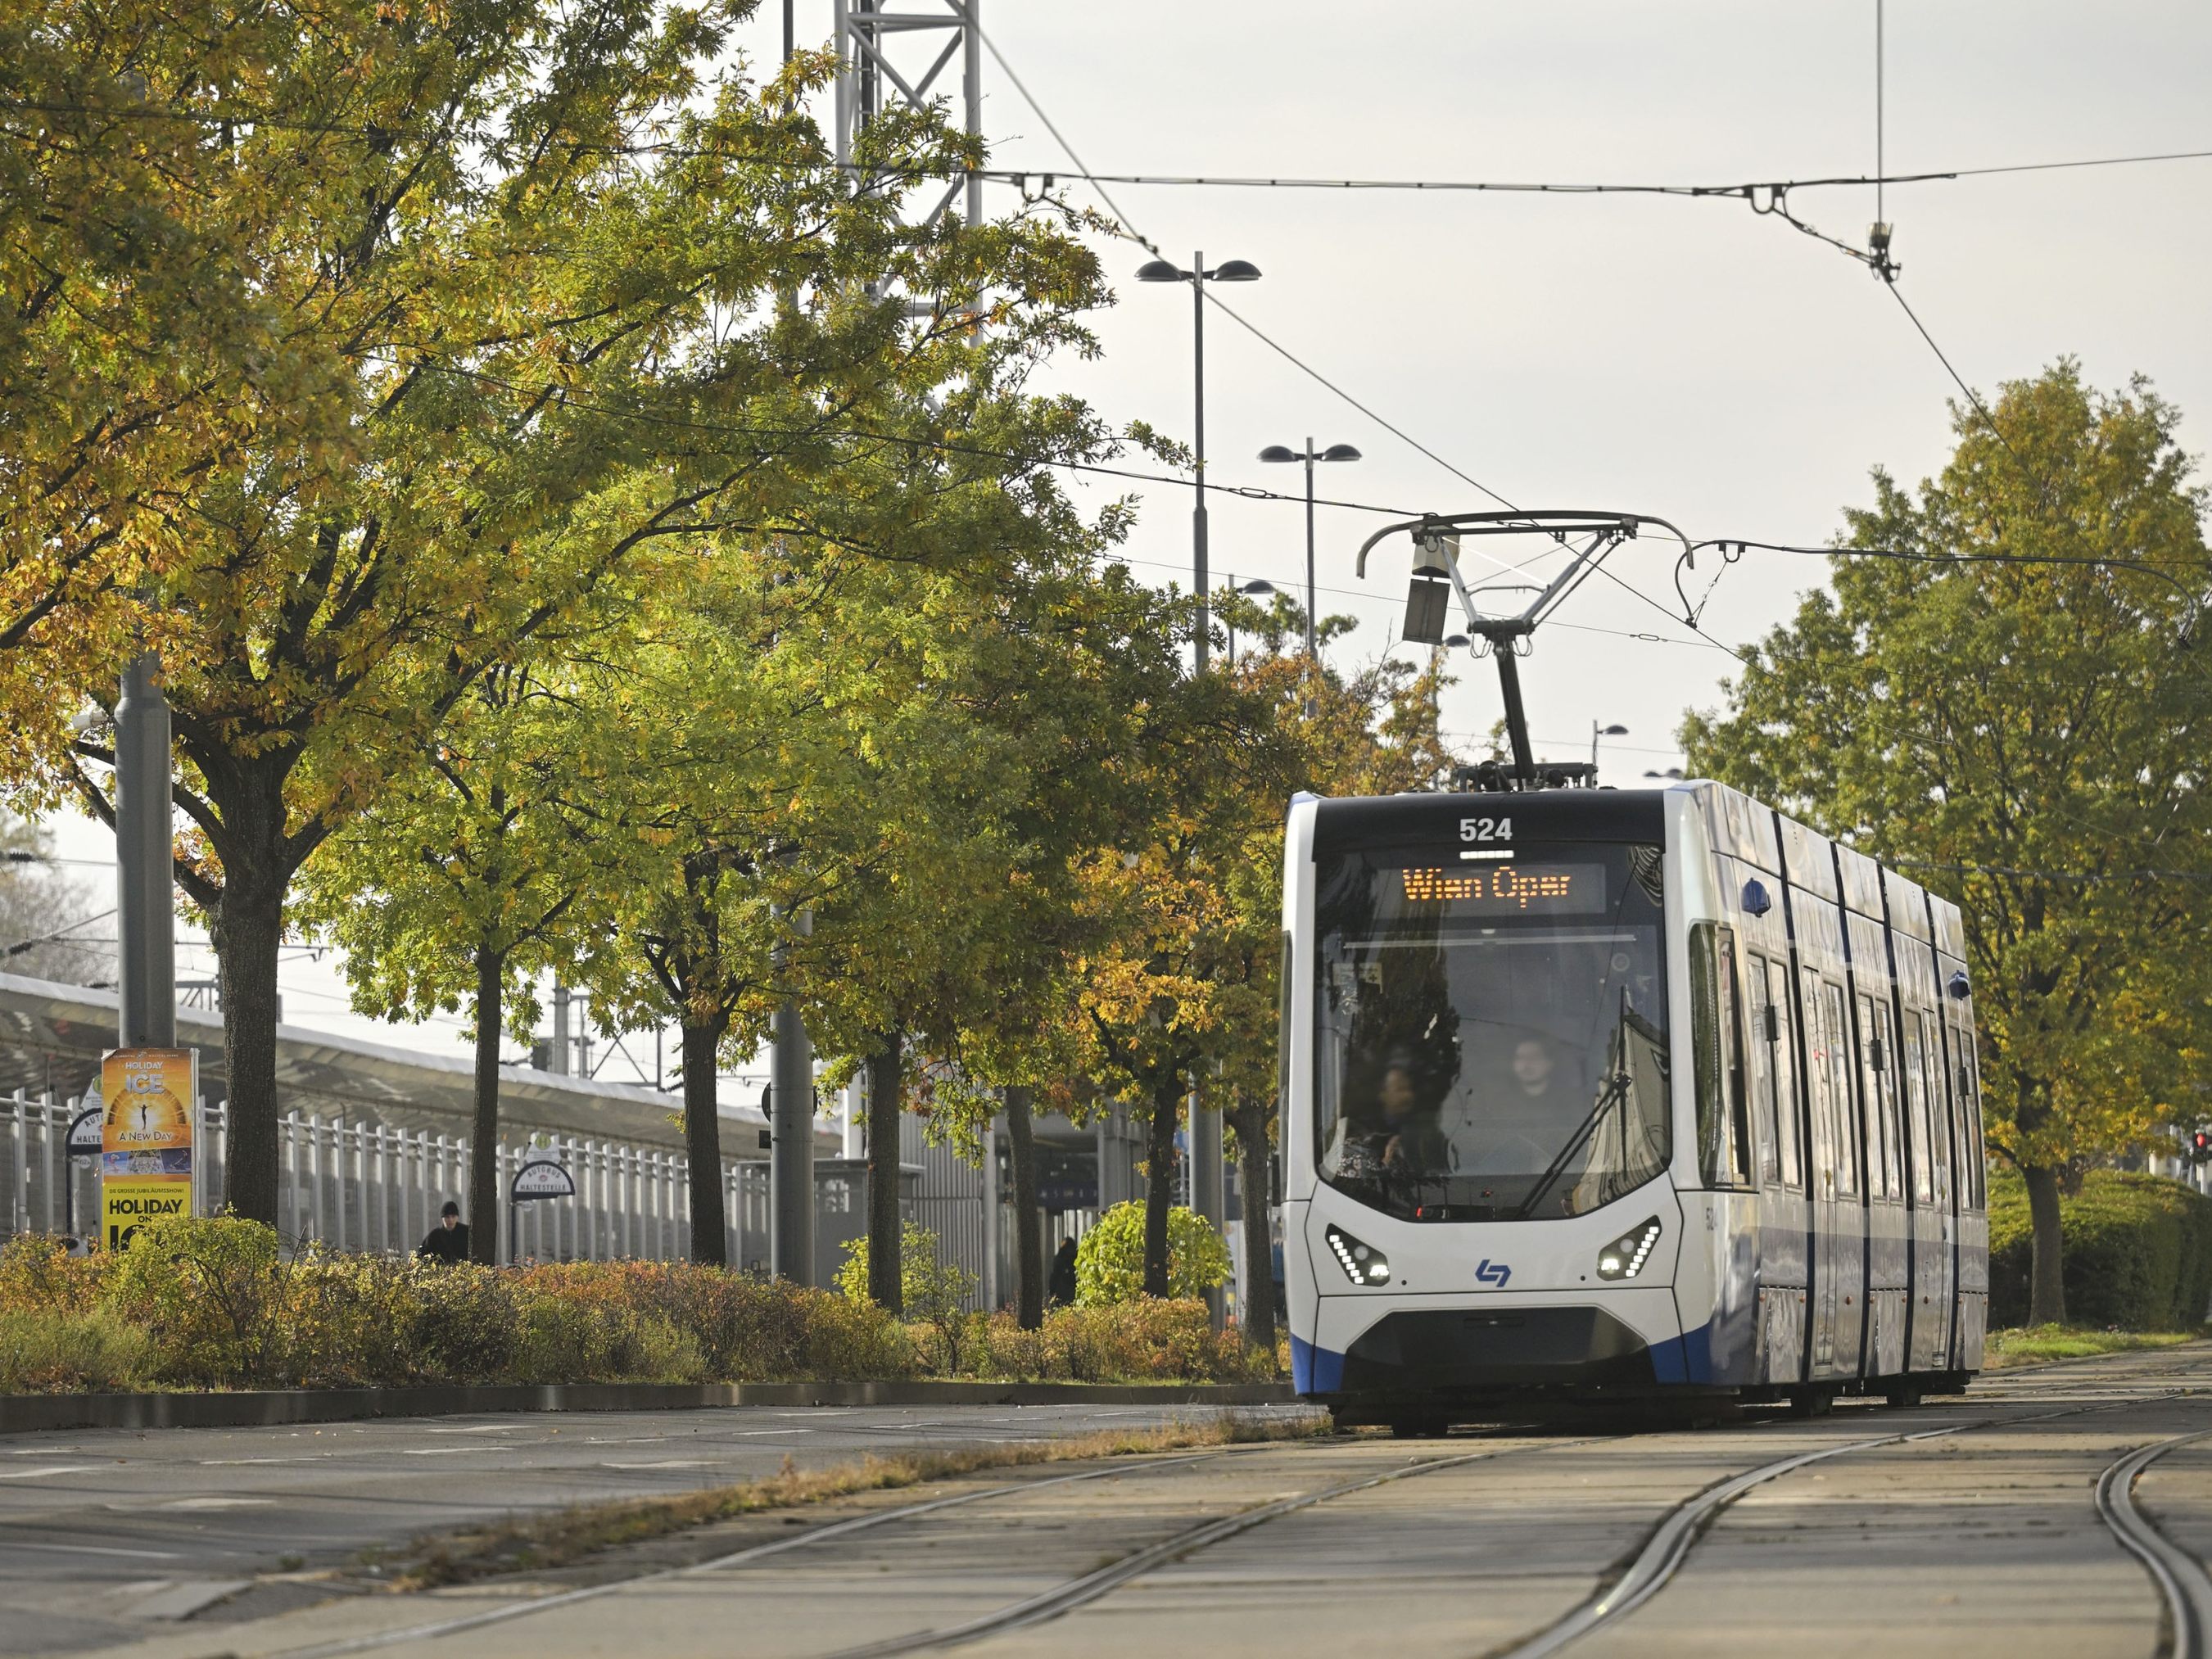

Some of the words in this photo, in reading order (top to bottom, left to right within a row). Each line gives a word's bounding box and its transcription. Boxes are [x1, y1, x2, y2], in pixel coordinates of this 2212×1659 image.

[1459, 818, 1513, 842] 524
[1402, 868, 1482, 900] Wien
[1492, 866, 1571, 908] Oper
[125, 1074, 165, 1094] ICE
[84, 1115, 103, 1128] AUT
[119, 1132, 126, 1141] A
[129, 1132, 151, 1141] NEW
[153, 1132, 172, 1141] DAY
[527, 1165, 561, 1178] AUTOBUS
[109, 1199, 183, 1214] HOLIDAY
